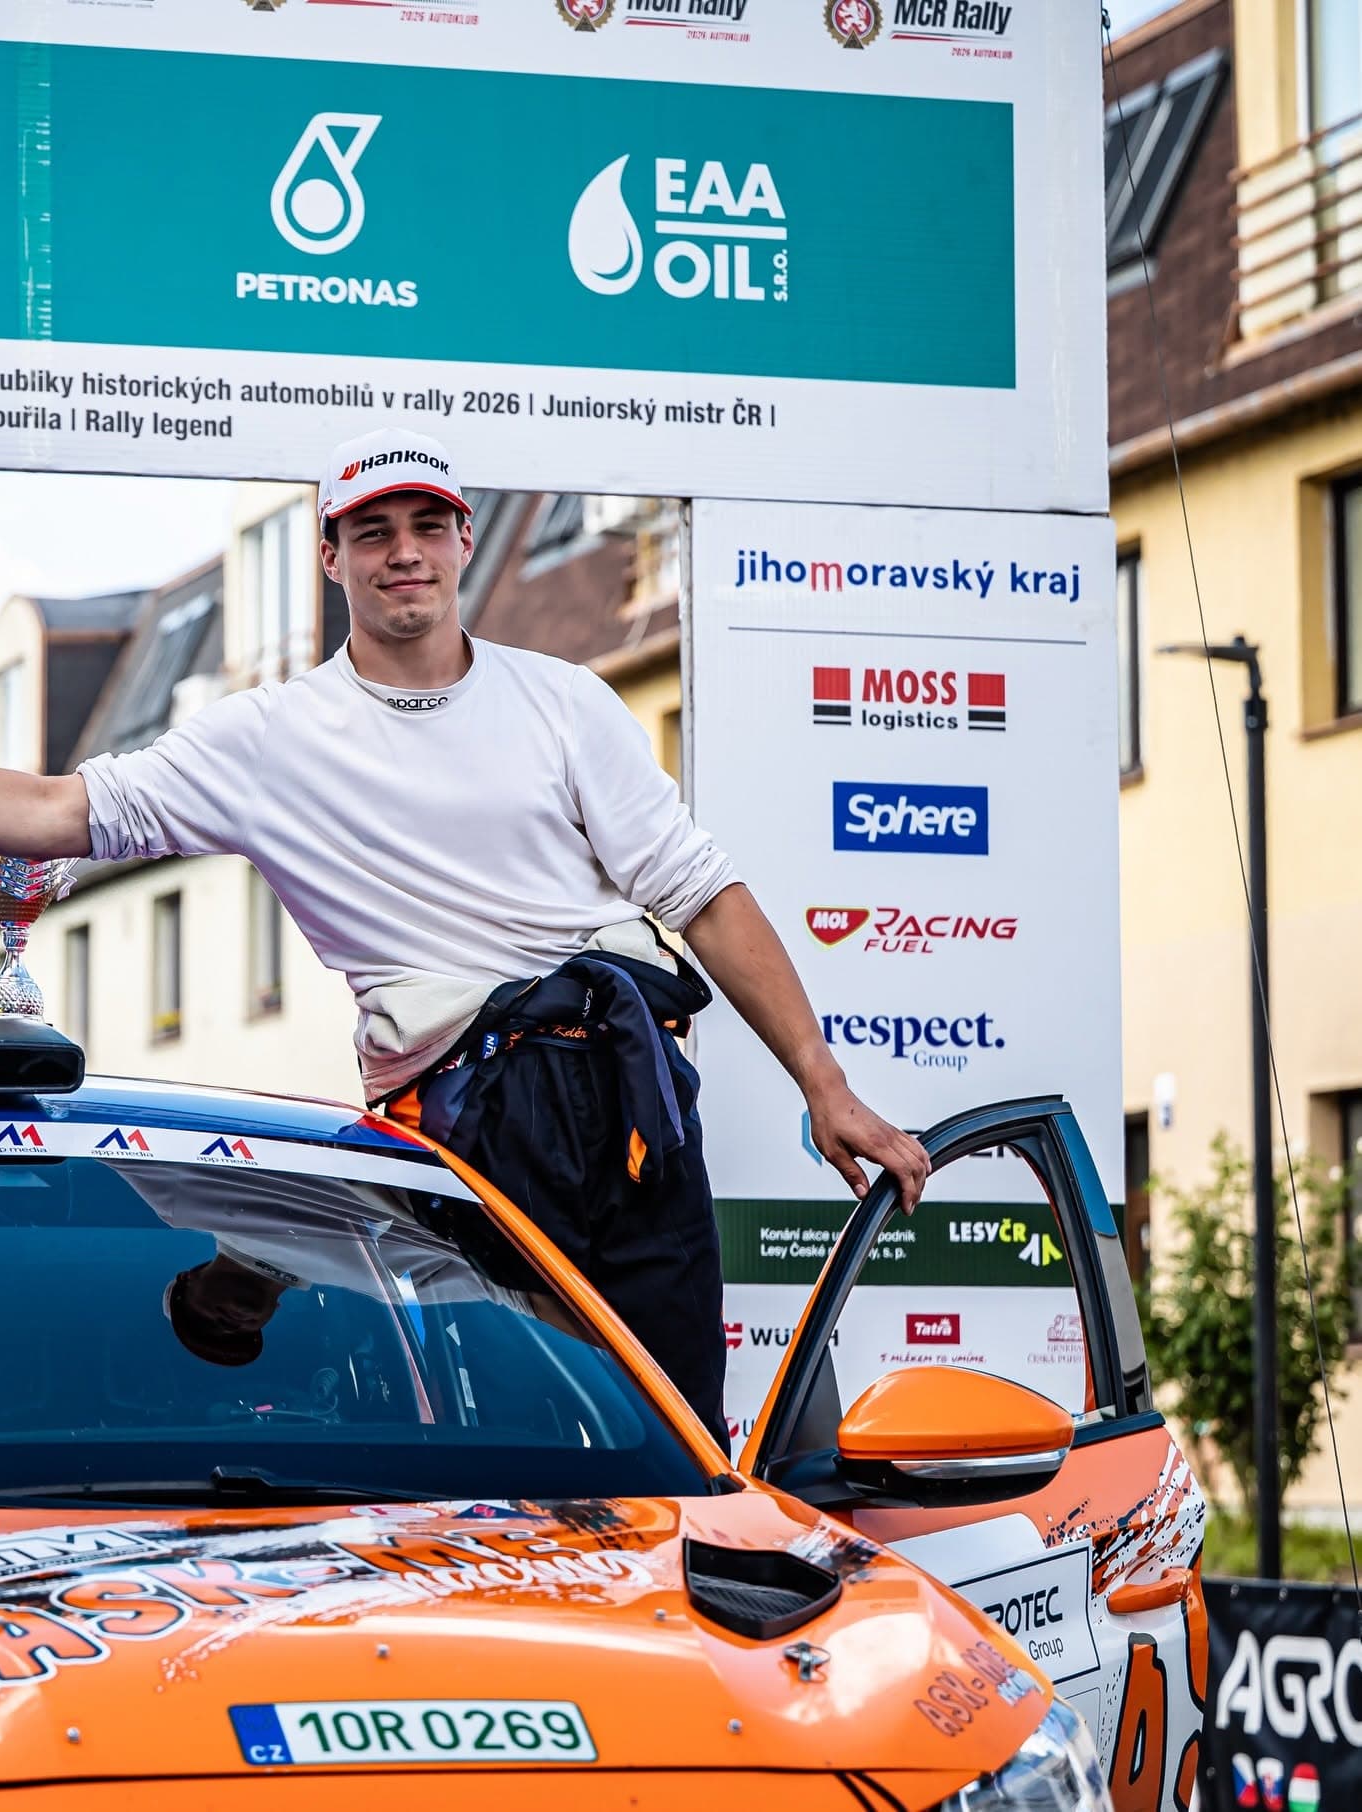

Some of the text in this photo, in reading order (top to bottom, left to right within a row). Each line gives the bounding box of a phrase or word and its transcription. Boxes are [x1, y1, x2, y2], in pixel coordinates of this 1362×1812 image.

[953, 0, 1013, 35] Rally
[655, 157, 786, 219] EAA
[654, 240, 765, 301] OIL
[774, 249, 788, 302] S.R.O.
[236, 272, 418, 307] PETRONAS
[82, 372, 232, 405] historických
[240, 381, 374, 409] automobilů
[382, 391, 395, 409] v
[403, 389, 453, 416] rally
[463, 391, 520, 416] 2026
[542, 395, 656, 426] Juniorský
[665, 400, 725, 425] mistr
[733, 398, 762, 426] ČR
[85, 409, 144, 439] Rally
[152, 412, 233, 439] legend
[735, 550, 1080, 603] jihomoravský kraj
[862, 668, 957, 705] MOSS
[861, 709, 958, 730] logistics
[846, 794, 976, 843] Sphere
[812, 911, 849, 930] MOL
[875, 908, 1018, 941] RACING
[864, 939, 934, 954] FUEL
[821, 1012, 1005, 1059] respect.
[913, 1051, 969, 1072] Group
[9, 1145, 47, 1153] media
[116, 1149, 154, 1158] media
[197, 1155, 258, 1167] app media
[760, 1243, 787, 1259] Lesy
[790, 1241, 826, 1257] České
[802, 1228, 830, 1242] akce
[1029, 1637, 1064, 1661] Group
[299, 1710, 582, 1752] 10R 0269
[250, 1745, 286, 1763] CZ
